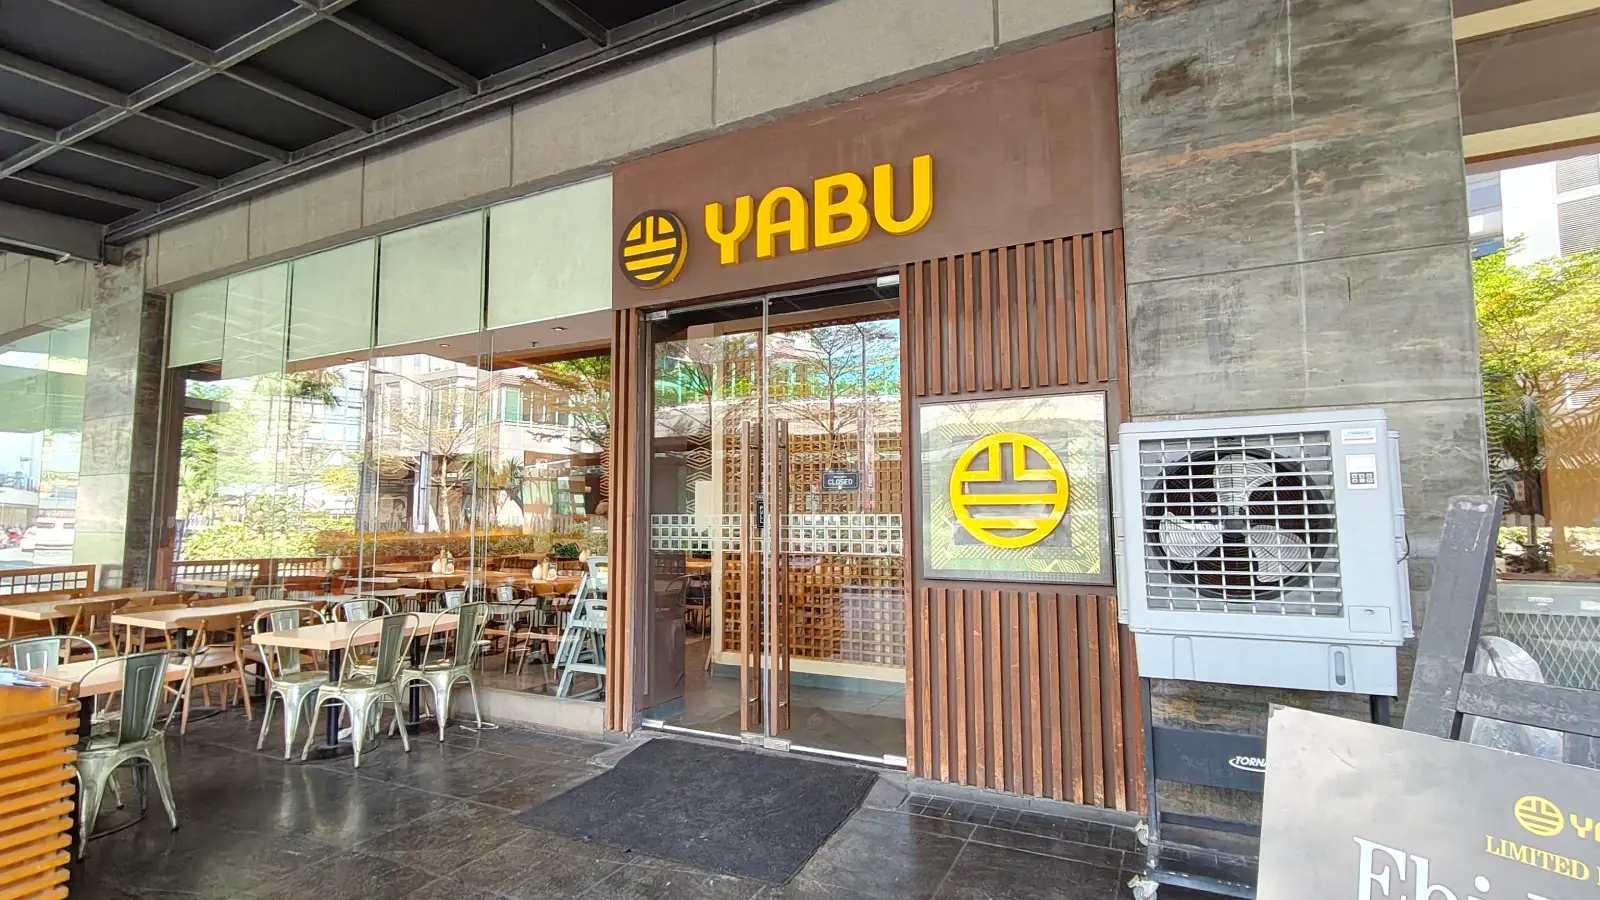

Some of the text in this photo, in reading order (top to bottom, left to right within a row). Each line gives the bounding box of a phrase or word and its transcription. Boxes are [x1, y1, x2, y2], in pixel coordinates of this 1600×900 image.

[705, 154, 933, 265] YABU
[828, 479, 852, 488] CLOSED
[1485, 834, 1590, 881] LIMITED
